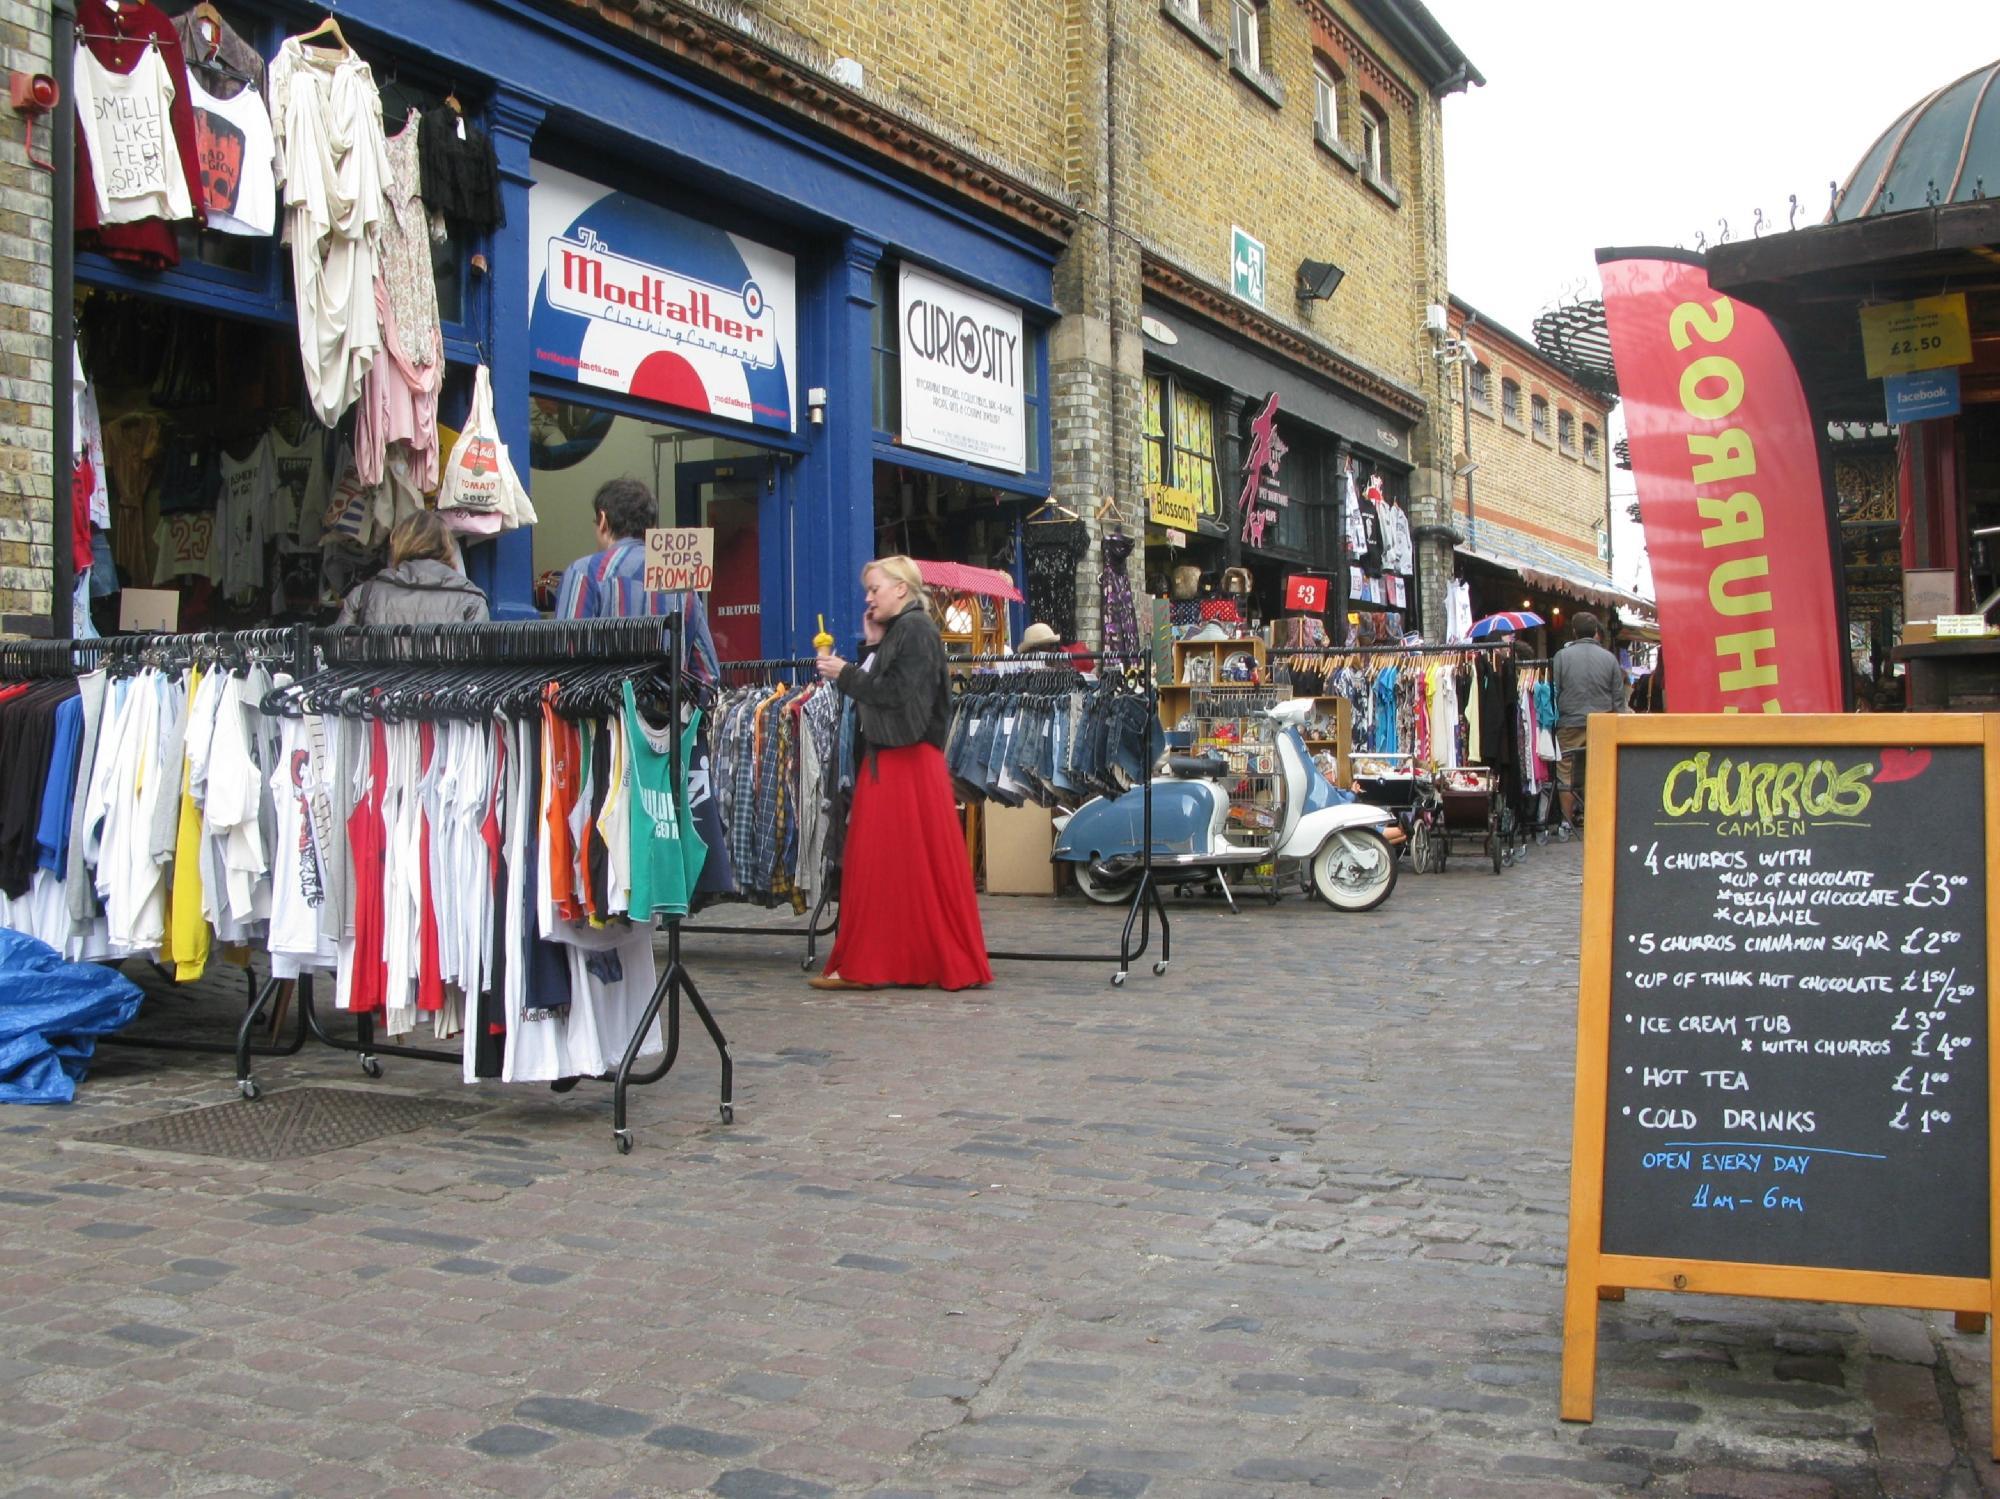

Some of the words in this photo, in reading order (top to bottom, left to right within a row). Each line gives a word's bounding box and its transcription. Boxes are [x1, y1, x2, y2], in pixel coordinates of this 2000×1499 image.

[578, 228, 608, 253] The
[561, 250, 763, 343] Modfather
[604, 305, 683, 346] Clothing
[687, 329, 758, 367] Company
[907, 300, 1017, 387] CURIOSITY
[1891, 336, 1942, 356] £2.50
[1897, 386, 1948, 403] facebook
[461, 479, 496, 491] TOMATO
[170, 518, 213, 562] 23
[651, 533, 698, 552] CROP
[662, 551, 702, 567] TOPS
[646, 566, 688, 589] FROM
[1297, 584, 1315, 604] £3
[1716, 820, 1806, 838] CAMDEN
[1644, 841, 1658, 875] 4
[1664, 852, 1748, 870] CHURROS
[1758, 849, 1812, 868] WITH
[1731, 874, 1759, 888] CUP
[1763, 873, 1782, 887] OF
[1788, 871, 1875, 888] CHOCOLATE
[1732, 889, 1807, 910] BELGIAN
[1810, 889, 1900, 907] CHOCOLATE
[1732, 908, 1821, 928] CARAMEL
[1638, 932, 1655, 954] 5
[1660, 935, 1737, 952] CHURROS
[1744, 934, 1826, 952] CINNAMON
[1832, 930, 1891, 956] SUGAR
[1635, 972, 1668, 990] CUP
[1673, 971, 1697, 988] OF
[1758, 972, 1795, 988] HOT
[1799, 975, 1894, 993] CHOCOLATE
[1640, 1016, 1672, 1034] ICE
[1679, 1015, 1737, 1035] CREAM
[1745, 1015, 1791, 1034] TUB
[1761, 1039, 1808, 1055] WITH
[1814, 1039, 1891, 1055] CHURROS
[1643, 1067, 1688, 1087] HOT
[1700, 1069, 1750, 1091] TEA
[1638, 1107, 1697, 1130] COLD
[1724, 1108, 1816, 1133] DRINKS
[1642, 1151, 1691, 1170] OPEN
[1702, 1153, 1762, 1173] EVERY
[1774, 1155, 1810, 1175] DAY
